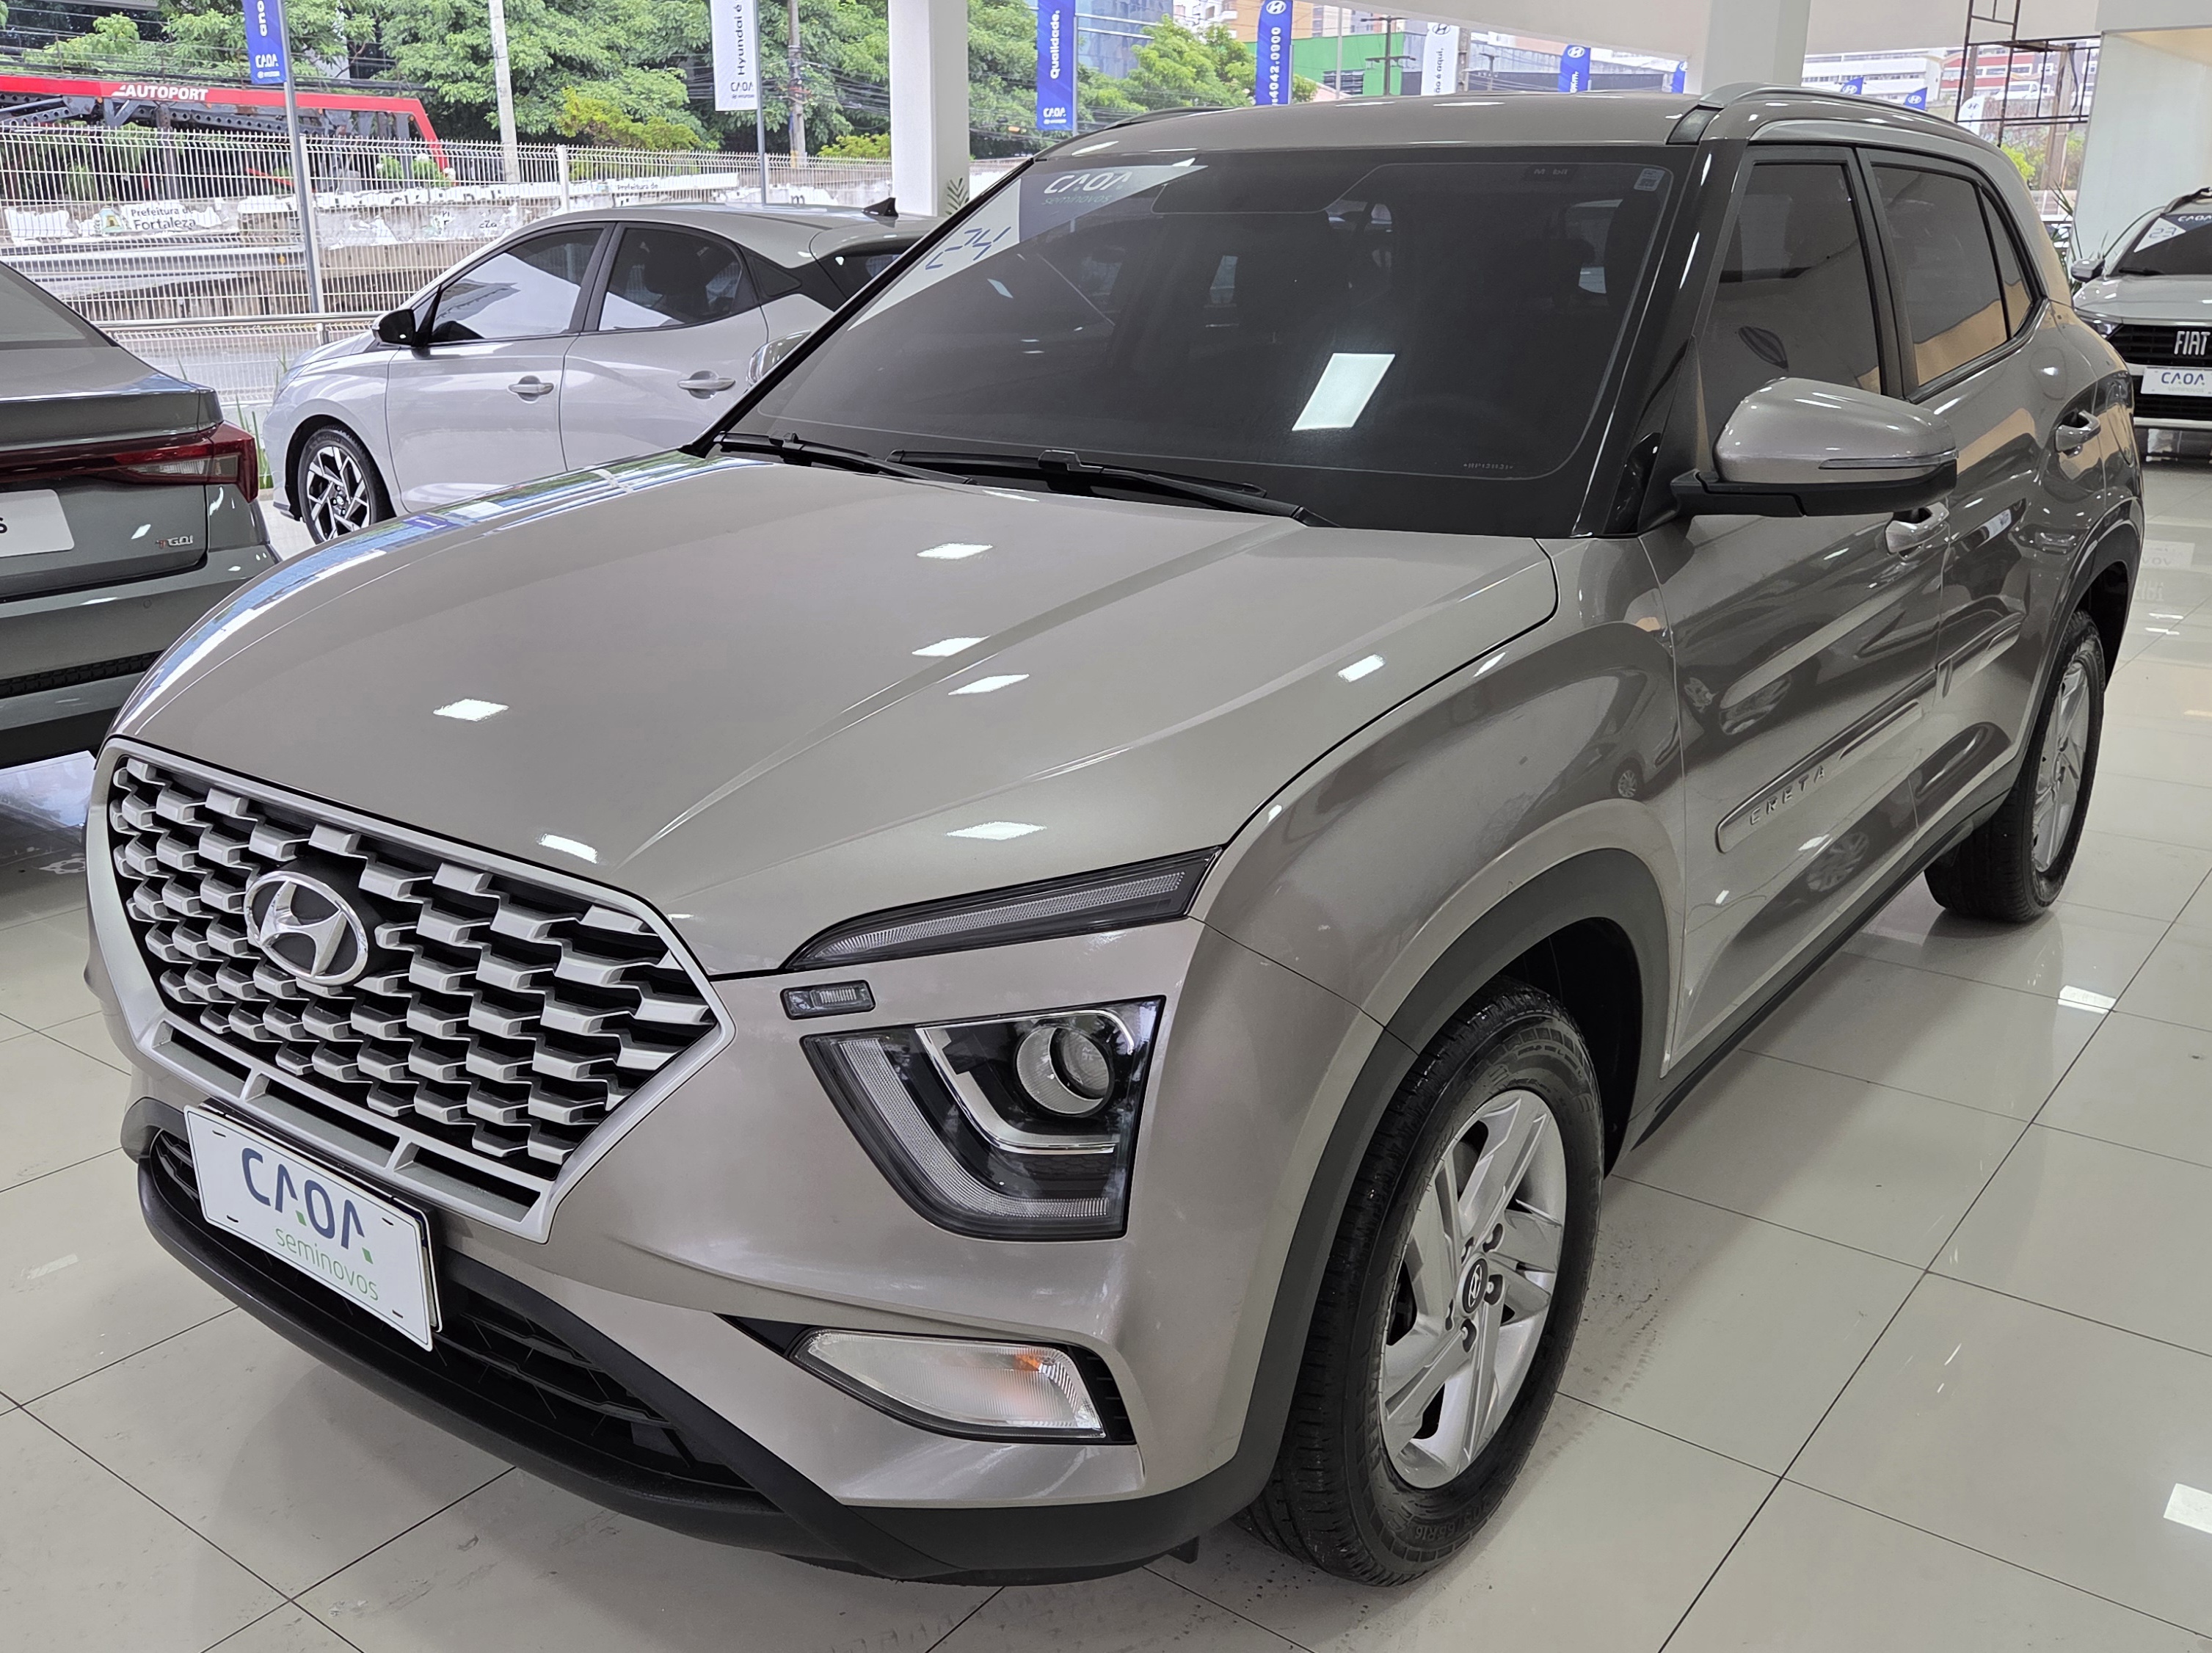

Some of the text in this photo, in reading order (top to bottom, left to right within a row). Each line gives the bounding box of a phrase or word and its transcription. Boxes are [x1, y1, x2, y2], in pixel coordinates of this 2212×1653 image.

[734, 16, 746, 76] Hyundai
[255, 53, 280, 68] CAOA
[124, 84, 208, 101] AUTOPORT
[730, 81, 754, 92] CAOA
[1043, 107, 1066, 118] CAOA
[1044, 171, 1133, 195] CAOA
[131, 208, 180, 217] Prefeitura
[134, 217, 196, 230] Fortaleza
[2174, 330, 2211, 355] FIAT
[2161, 371, 2205, 386] CAOA
[1749, 765, 1826, 826] CRETA
[241, 1147, 374, 1265] CAOA
[275, 1227, 379, 1301] seminovos
